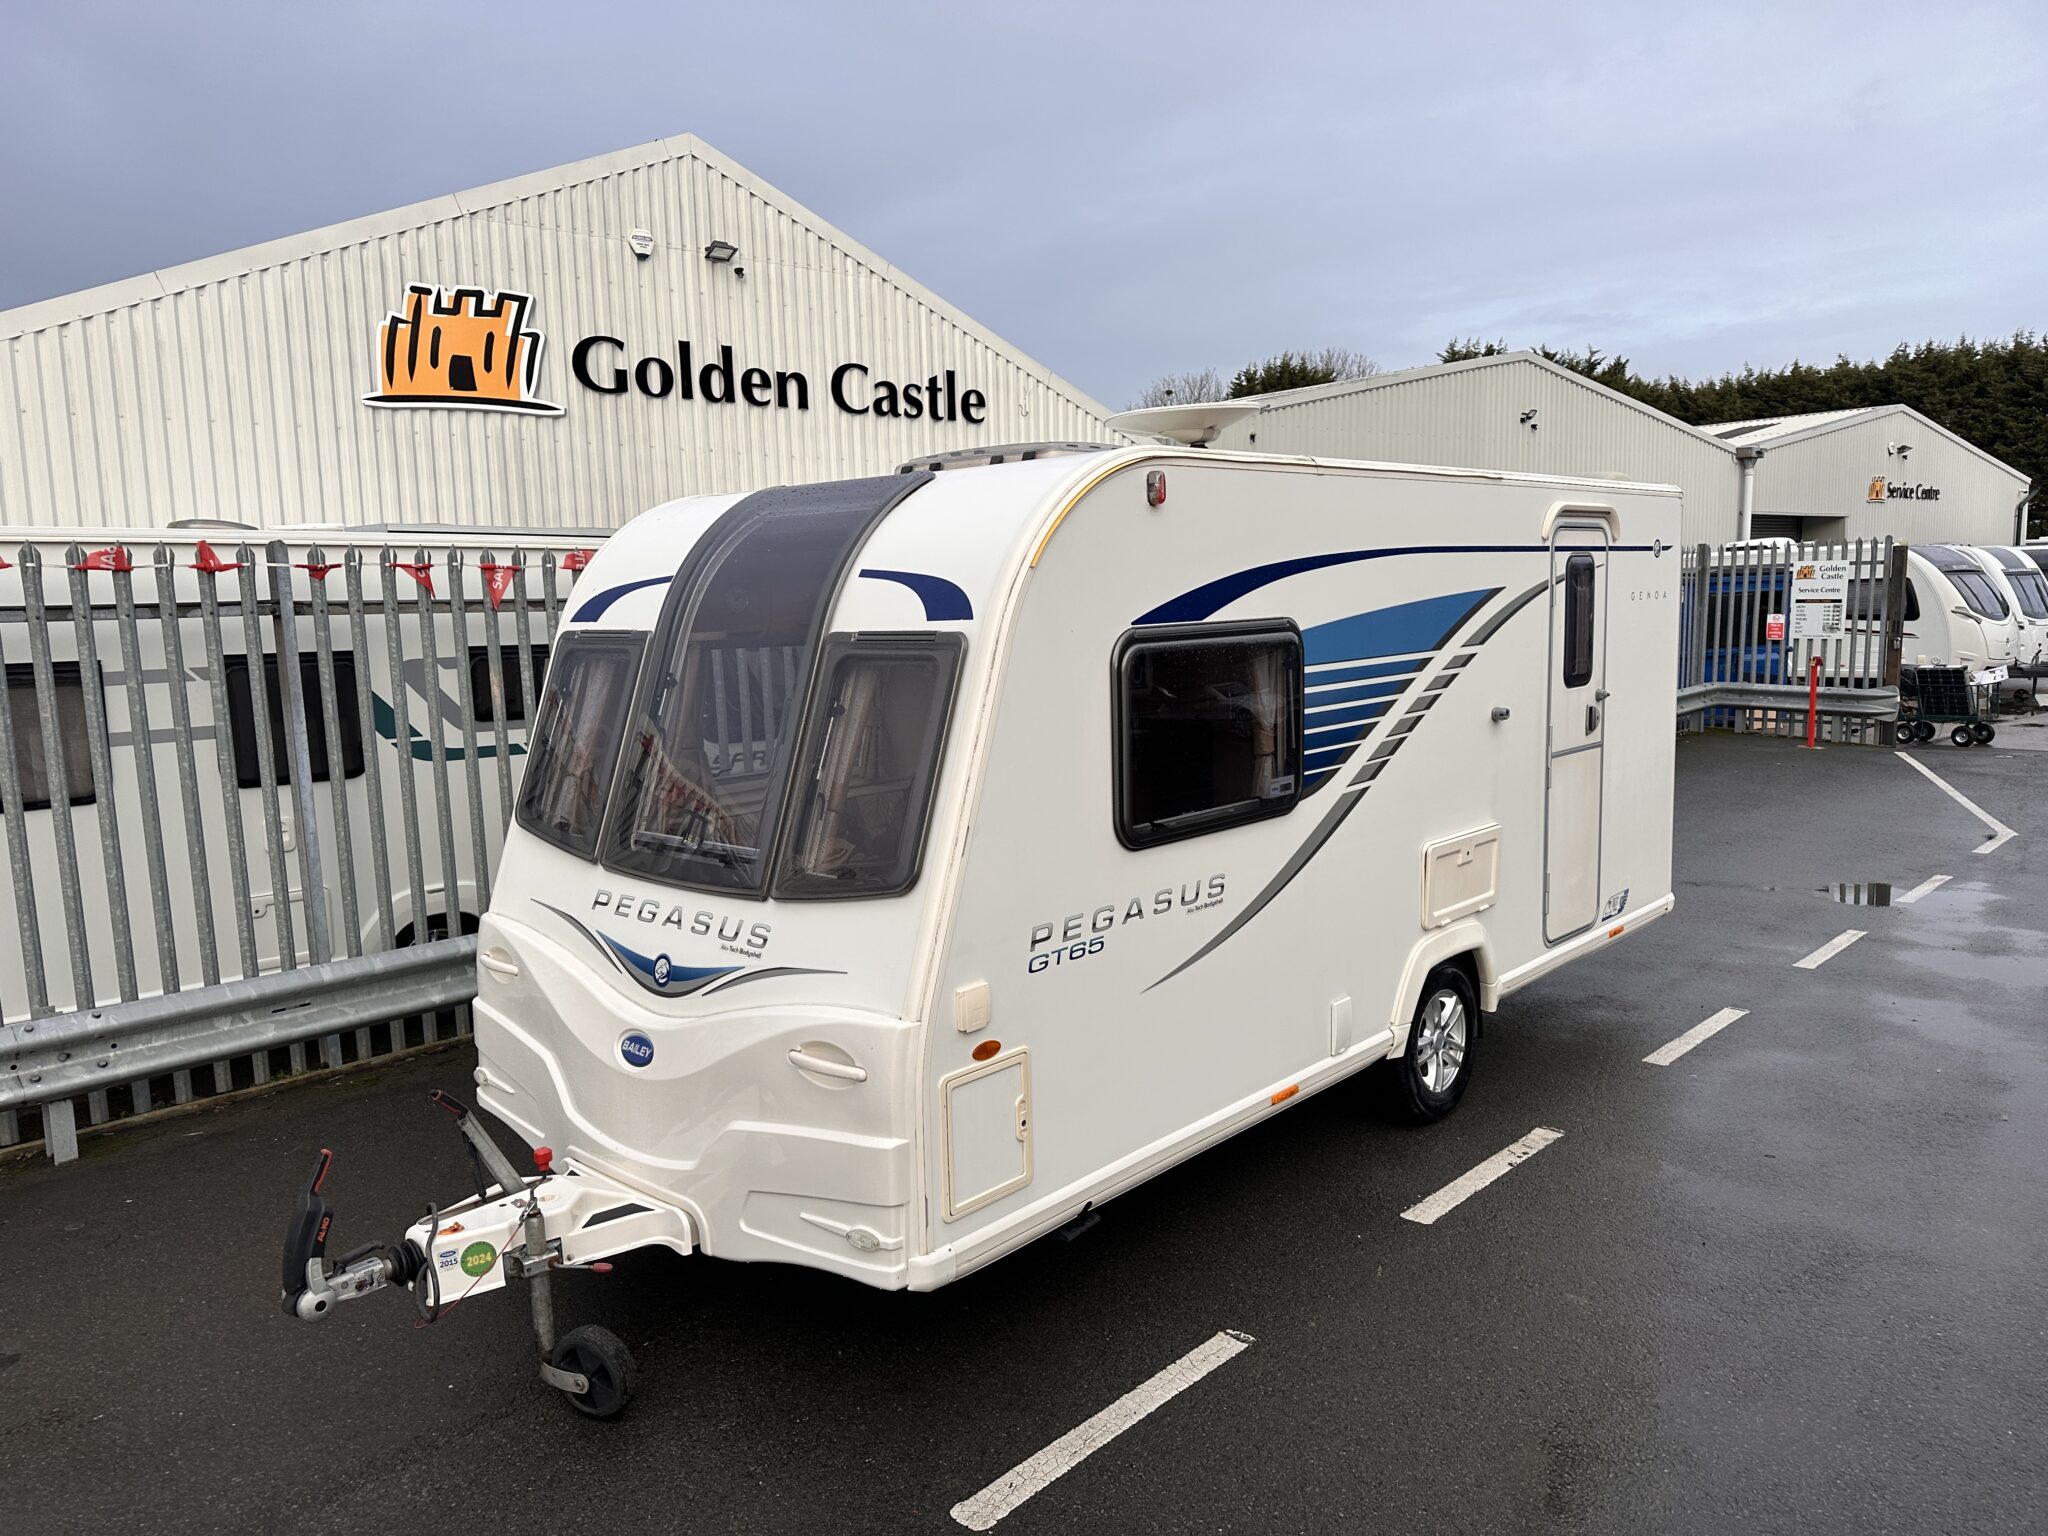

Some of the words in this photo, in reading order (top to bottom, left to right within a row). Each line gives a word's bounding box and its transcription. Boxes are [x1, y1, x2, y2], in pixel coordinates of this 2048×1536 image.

[571, 335, 809, 411] Golden
[830, 361, 987, 425] Castle
[1887, 481, 1914, 499] Service
[1916, 483, 1940, 501] Centre
[1819, 564, 1846, 572] Golden
[1631, 590, 1667, 601] GENOA
[591, 889, 772, 949] PEGASUS
[1029, 873, 1226, 952] PEGASUS
[1028, 935, 1105, 974] GT65
[622, 1040, 652, 1058] BAILEY
[439, 1257, 459, 1268] 2015
[466, 1251, 492, 1267] 2024
